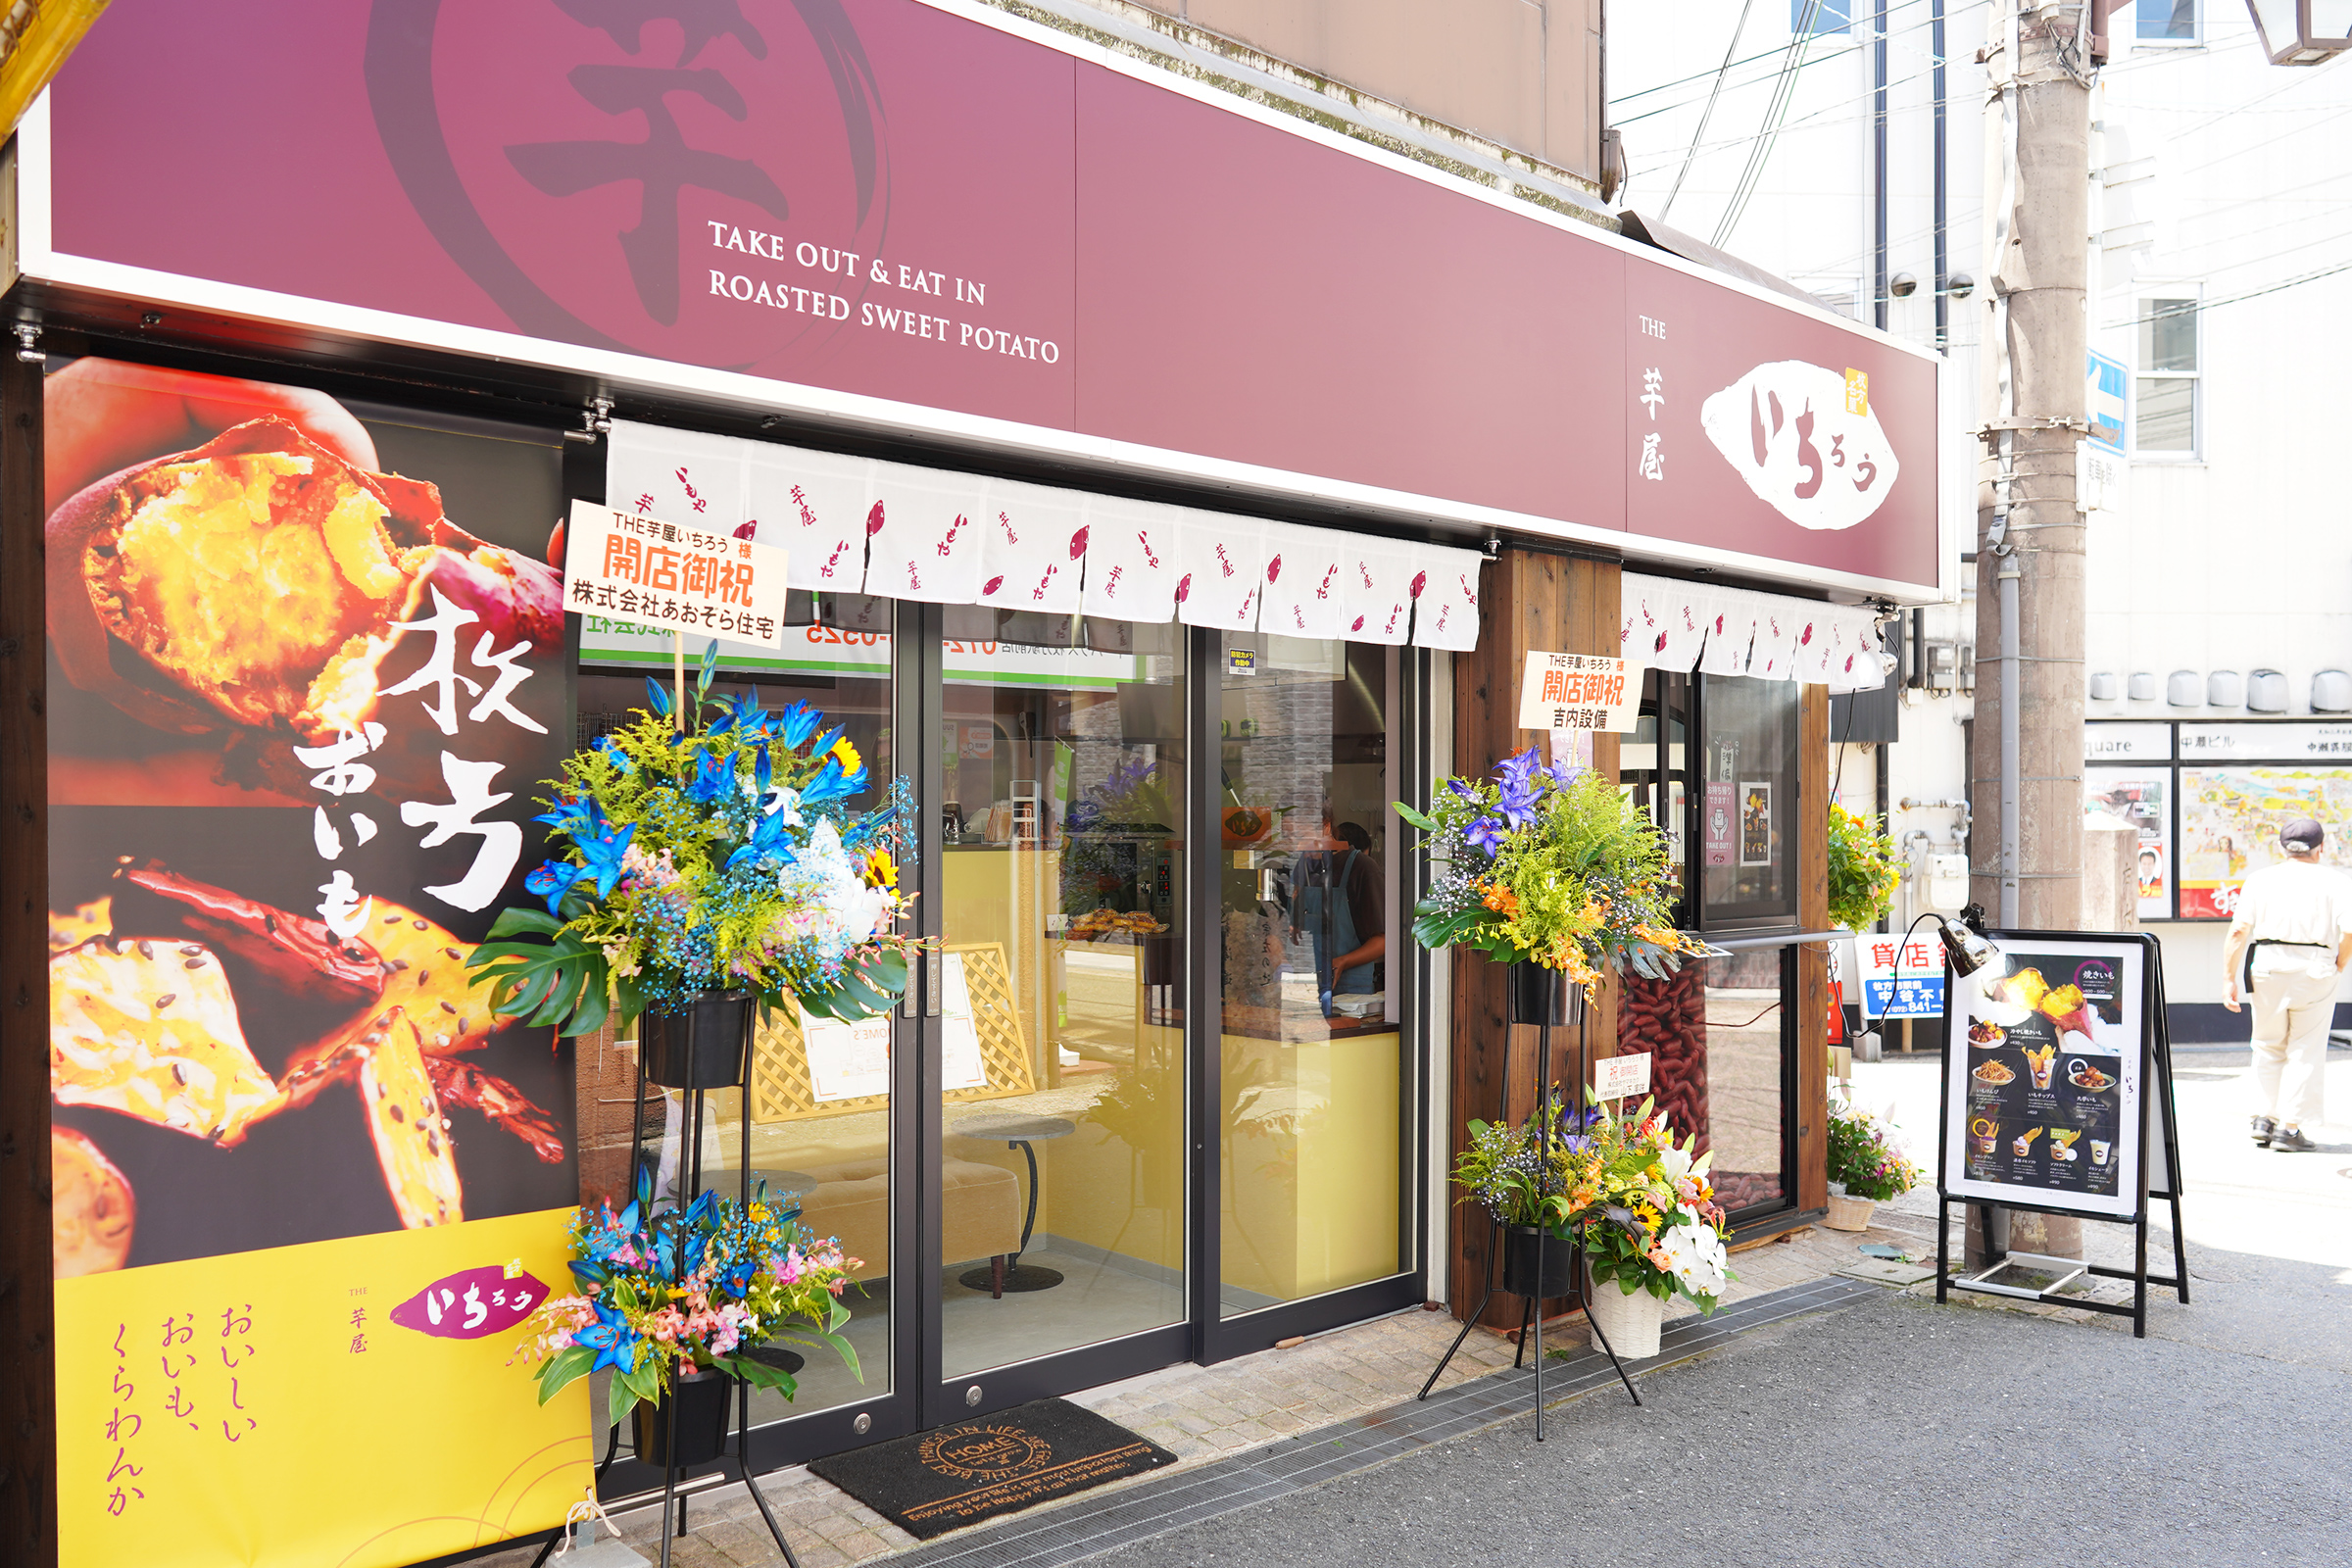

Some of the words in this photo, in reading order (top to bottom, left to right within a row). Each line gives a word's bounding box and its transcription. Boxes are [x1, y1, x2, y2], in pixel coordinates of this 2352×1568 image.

[708, 220, 784, 262] TAKE
[796, 241, 859, 277] OUT
[869, 259, 891, 285] &
[898, 264, 945, 296] EAT
[956, 277, 985, 306] IN
[709, 269, 850, 321] ROASTED
[861, 302, 950, 342] SWEET
[959, 321, 1059, 365] POTATO
[1639, 314, 1666, 340] THE
[1639, 367, 1665, 481] 芋屋
[1750, 383, 1878, 500] いちろう
[674, 466, 707, 514] いもや
[612, 512, 728, 554] THE芋屋いちろう
[602, 533, 755, 608] 開店御祝
[571, 578, 775, 641] 株式会社あおぞら住宅
[1548, 654, 1612, 671] THE芋屋いちろう
[1542, 670, 1625, 707] 開店御祝
[1553, 708, 1608, 730] 吉内設備
[2180, 734, 2235, 750] 中瀬ビル
[1707, 785, 1732, 795] お持ち帰り
[293, 721, 388, 938] おいも
[2082, 970, 2115, 980] 焼きいも
[1878, 989, 1944, 1004] 中谷不
[349, 1287, 368, 1297] THE
[426, 1281, 533, 1330] いちろう
[349, 1306, 368, 1354] 芋屋
[220, 1303, 257, 1443] おいしい
[105, 1323, 145, 1516] くらわんか
[945, 1436, 1016, 1460] HOME
[907, 1501, 963, 1521] Enjoying
[990, 1491, 1032, 1505] happy
